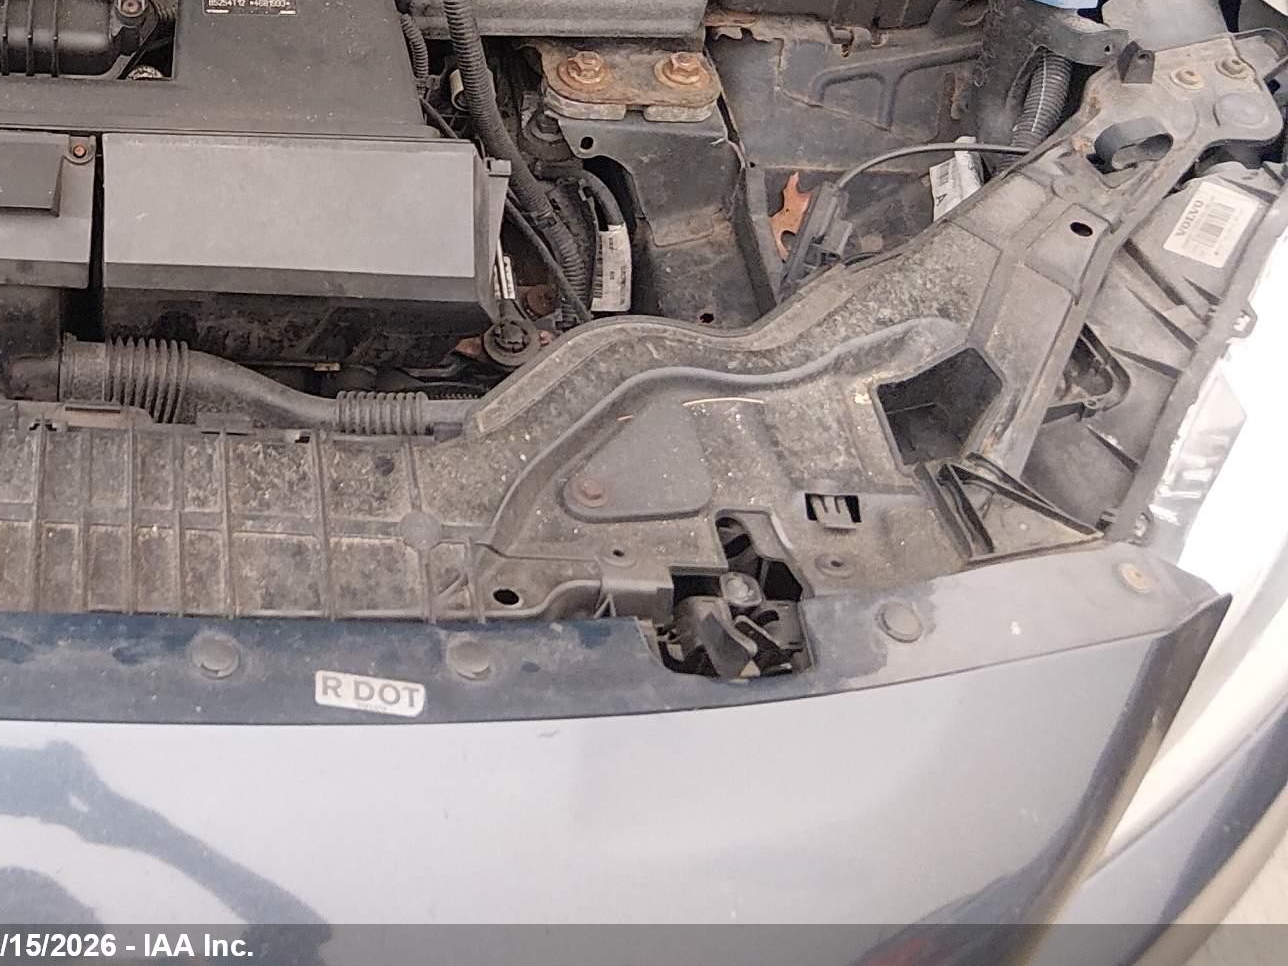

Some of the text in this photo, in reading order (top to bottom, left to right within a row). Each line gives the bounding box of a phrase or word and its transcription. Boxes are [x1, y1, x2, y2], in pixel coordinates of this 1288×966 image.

[1175, 199, 1204, 236] VOLVO
[321, 675, 343, 698] R
[353, 680, 420, 707] DOT
